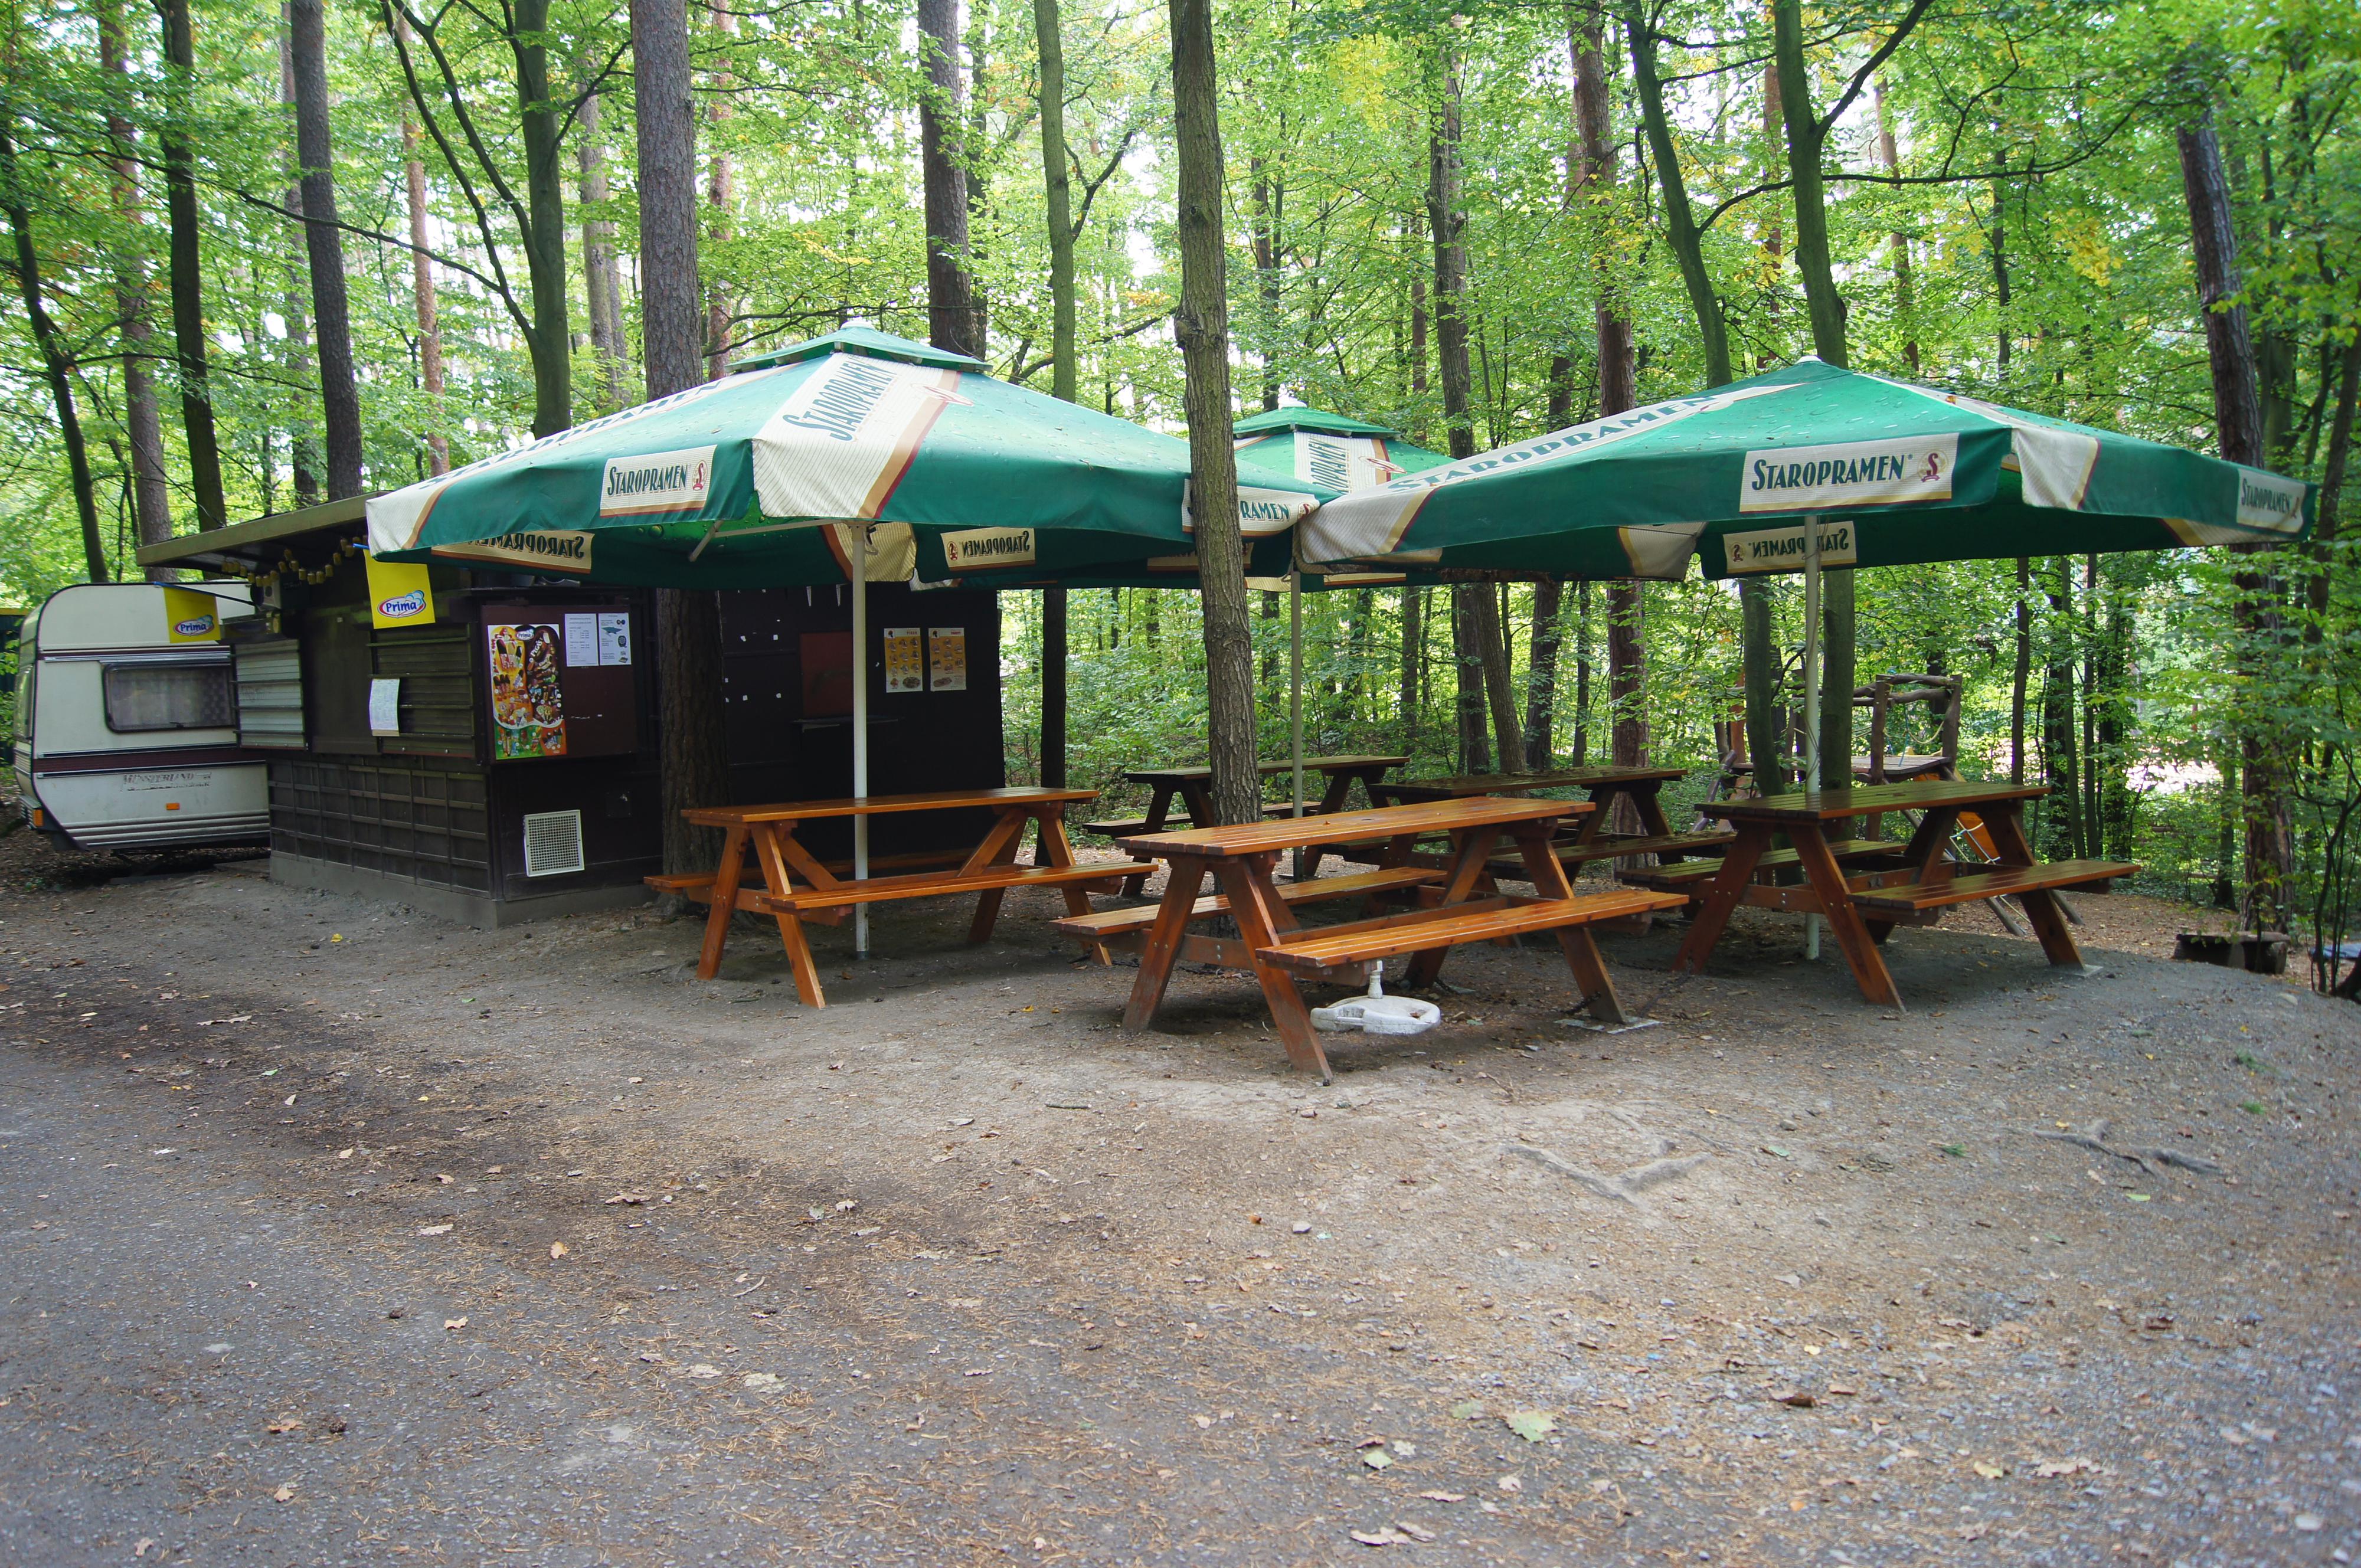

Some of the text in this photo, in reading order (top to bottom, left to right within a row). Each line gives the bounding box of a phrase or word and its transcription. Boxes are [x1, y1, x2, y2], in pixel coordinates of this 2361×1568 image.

[783, 357, 897, 441] STAROPRAMEN
[1387, 397, 1716, 492] STAROPRAMEN
[607, 464, 688, 496] STAROPRAMEN
[1751, 454, 1905, 490] STAROPRAMEN
[2241, 478, 2291, 513] STAROPRAMEN
[386, 601, 417, 613] Prima
[181, 623, 207, 631] Prima
